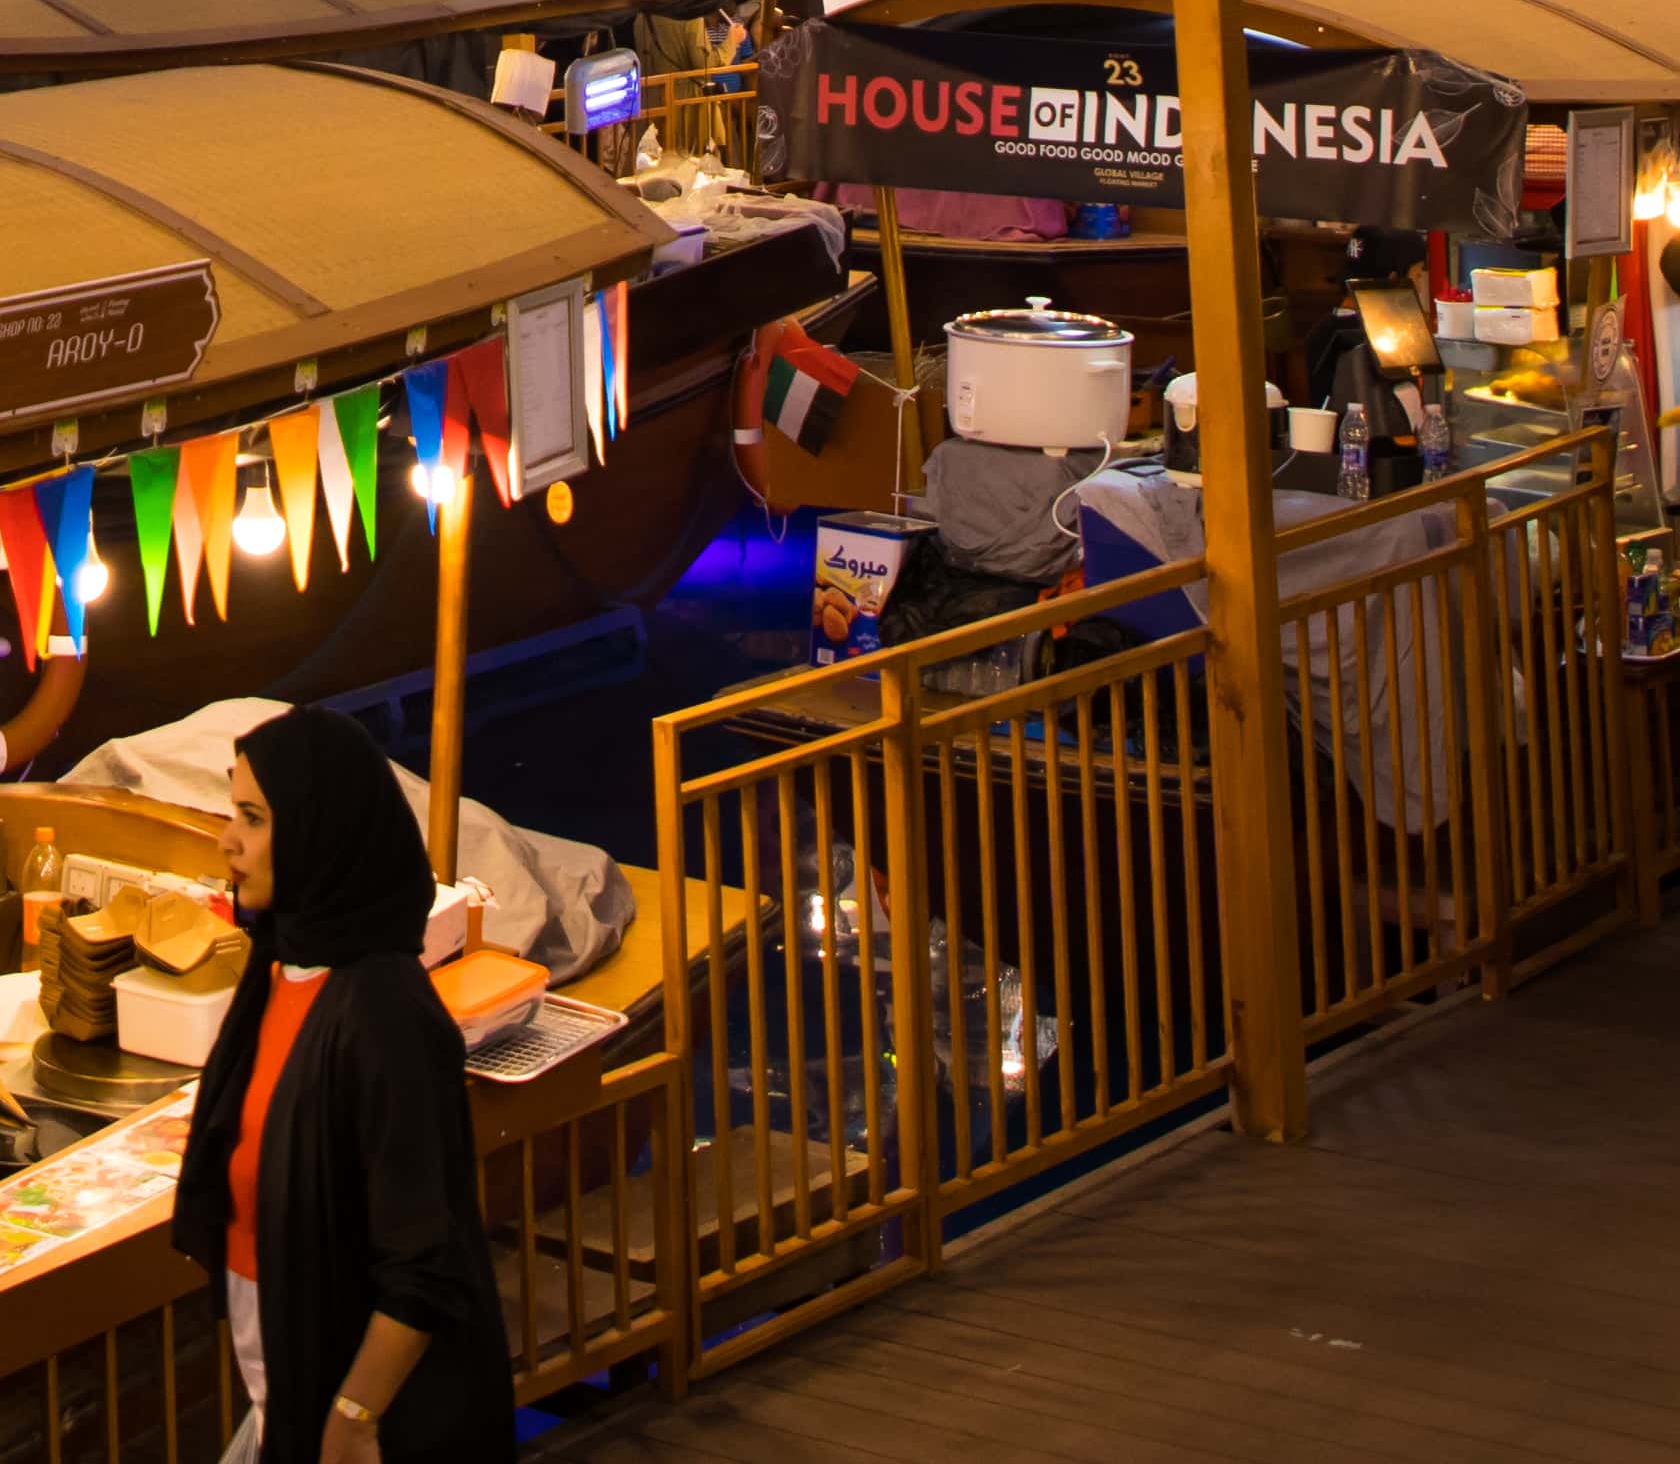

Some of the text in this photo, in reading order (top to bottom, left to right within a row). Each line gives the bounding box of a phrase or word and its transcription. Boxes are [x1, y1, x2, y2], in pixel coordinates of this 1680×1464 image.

[1103, 58, 1143, 87] 23
[817, 73, 1448, 169] HOUSE OF INDNESIA
[995, 140, 1036, 156] GOOD
[1039, 143, 1078, 160] FOOD
[1080, 147, 1124, 163] GOOD
[1126, 150, 1171, 167] MOOD
[1093, 167, 1164, 181] GLOBAL VILLAGE
[47, 312, 62, 330] 22
